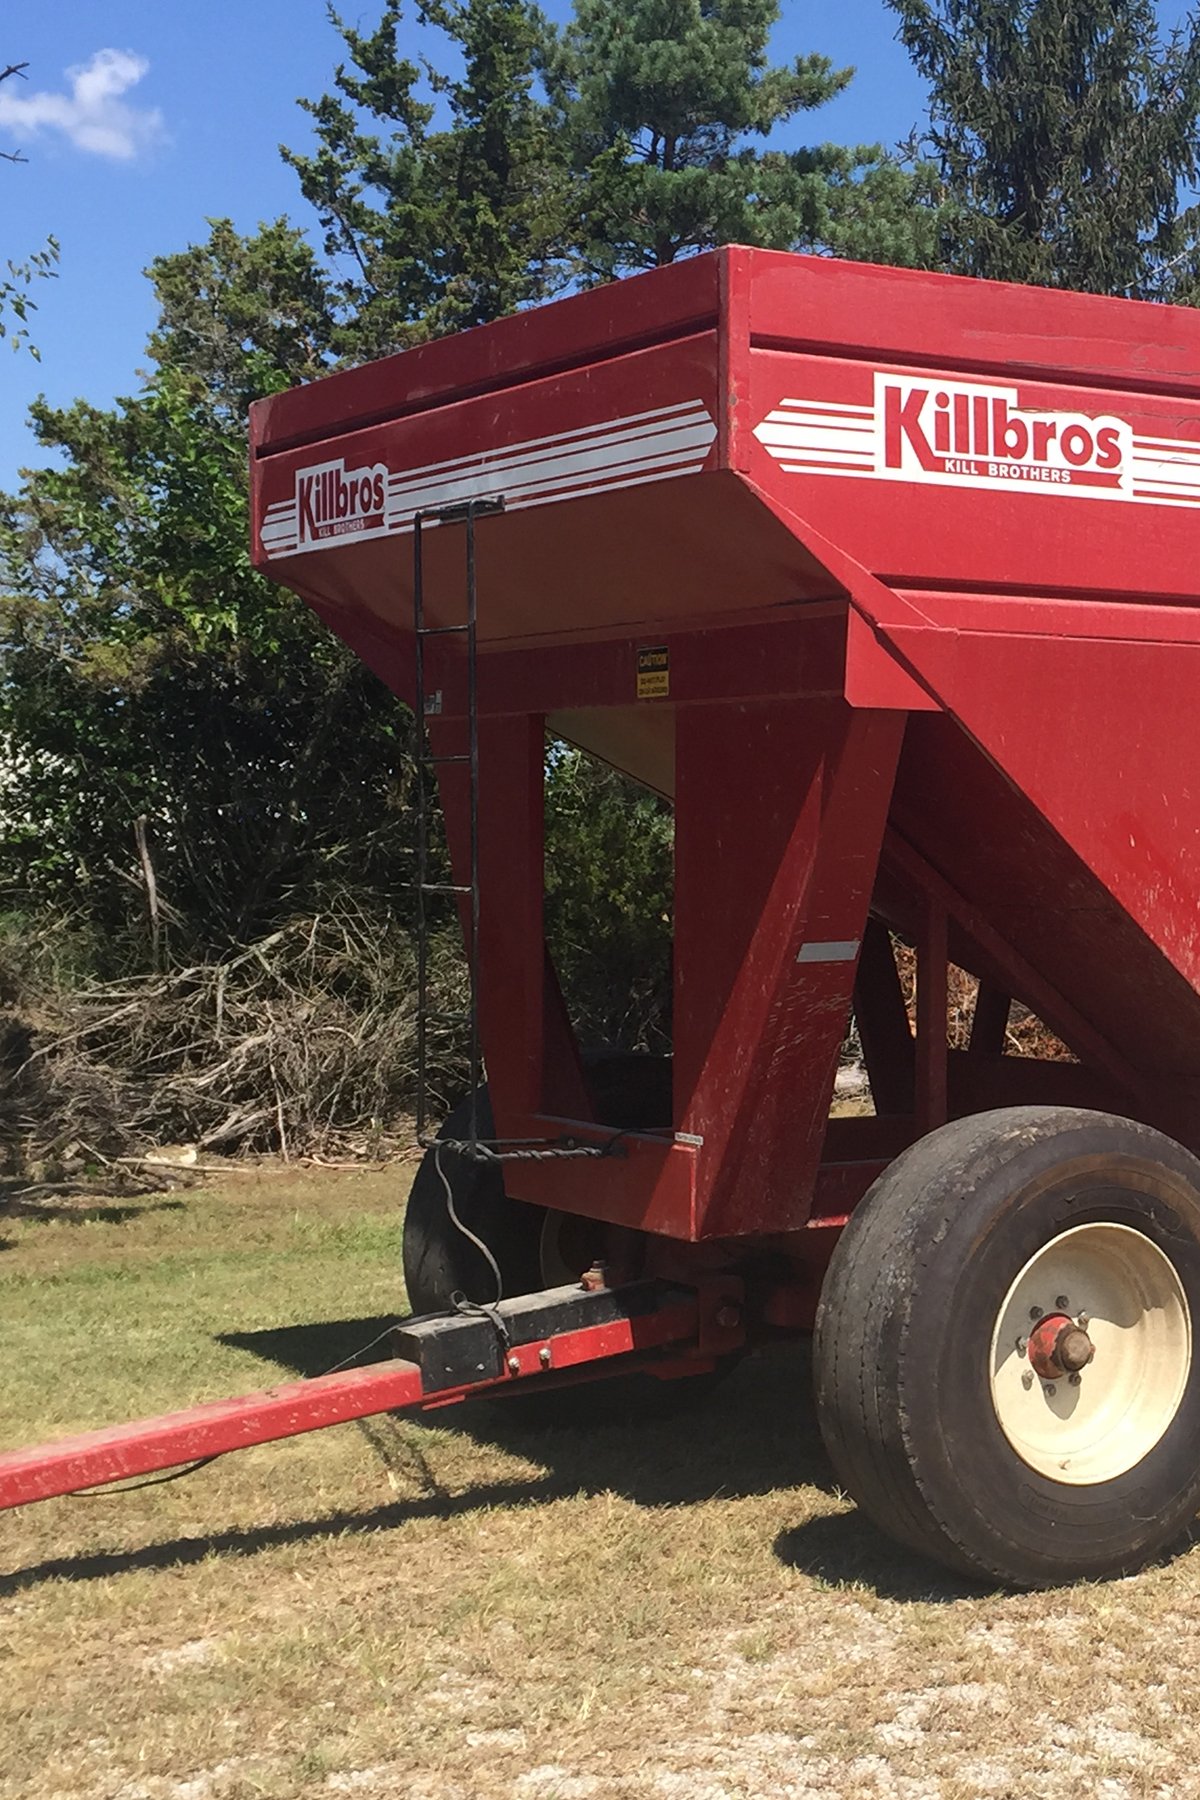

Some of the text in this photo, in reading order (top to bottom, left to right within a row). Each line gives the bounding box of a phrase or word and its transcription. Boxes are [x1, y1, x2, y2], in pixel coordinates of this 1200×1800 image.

[885, 385, 1122, 471] Killbros
[299, 468, 384, 542] Killbros
[945, 459, 1071, 483] KILL BROTHERS
